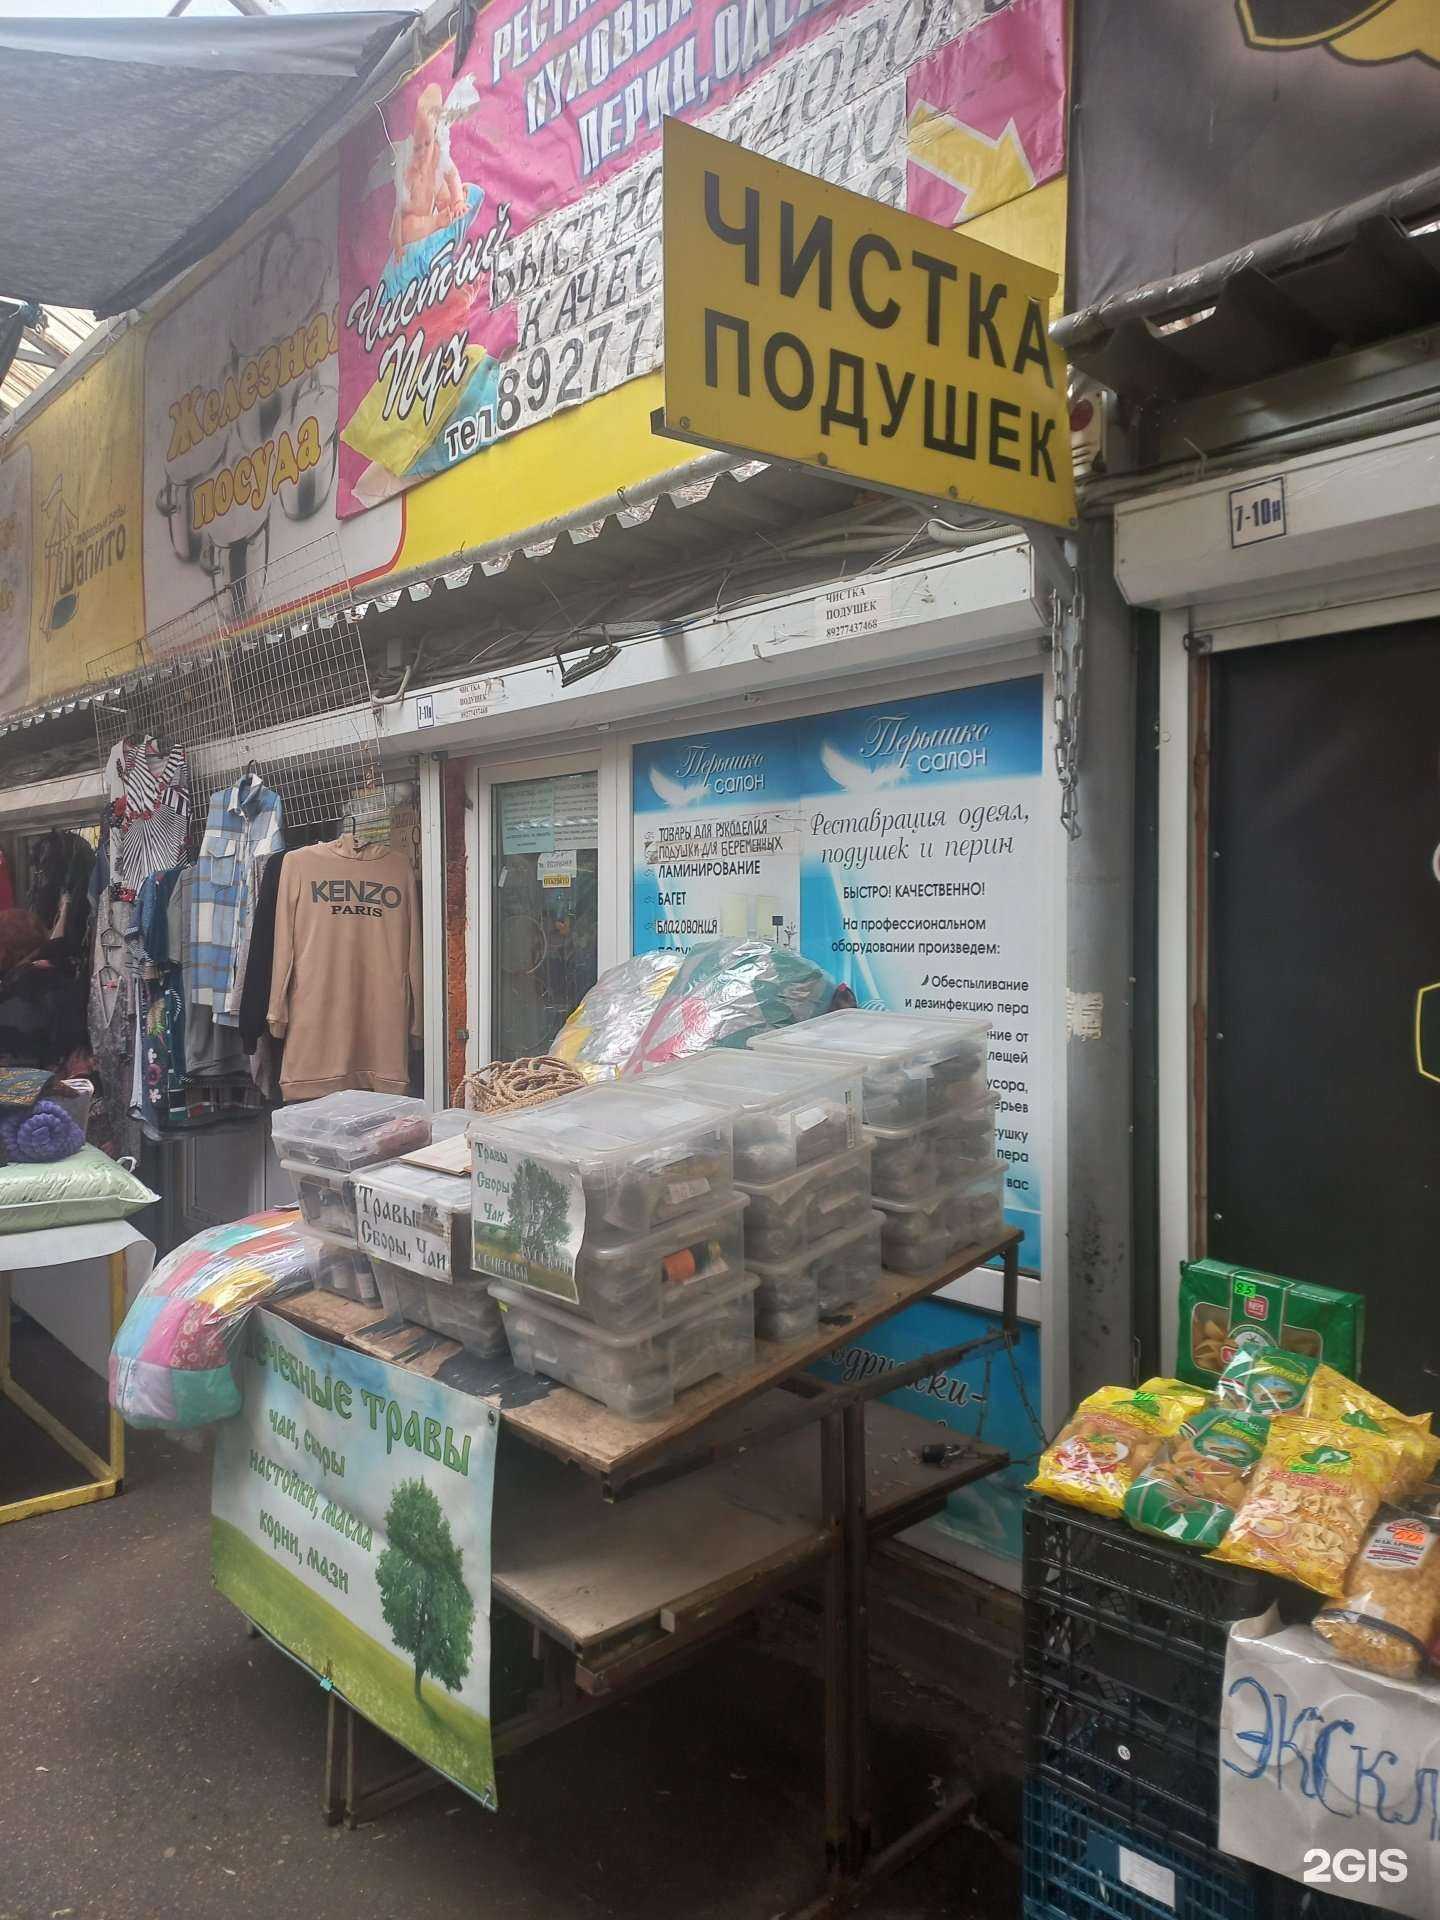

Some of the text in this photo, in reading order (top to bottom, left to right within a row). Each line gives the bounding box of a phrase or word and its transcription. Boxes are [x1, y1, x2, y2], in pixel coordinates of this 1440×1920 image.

[490, 165, 663, 312] БЫСТРО
[345, 202, 513, 352] Чистый
[703, 170, 1056, 389] ЧИСТКА
[495, 302, 663, 432] 89277
[376, 330, 470, 426] Пух
[704, 307, 1058, 484] ПОДУШЕК
[826, 586, 866, 603] ЧИСТКА
[826, 600, 877, 620] ПОДУШЕК
[860, 713, 992, 770] Перышко
[659, 819, 768, 842] ТОВАРЫ ДЛЯ РУКОДЕЛИЯ
[811, 802, 1033, 838] Реставрация одеял,
[659, 842, 700, 859] ПОДУШКИ
[721, 836, 783, 857] БЕРЕМЕННЫХ
[821, 836, 1015, 870] подушек и перин
[658, 860, 761, 879] ЛАМИНИРОВАНИЕ
[311, 879, 402, 909] KENZO
[657, 892, 687, 906] БАГЕТ
[843, 882, 986, 899] БЫСТРО! КАЧЕСТВЕННО!
[331, 905, 383, 918] PARIS
[843, 917, 986, 933] На профессиональном
[831, 939, 1001, 956] оборудовании произведем:
[931, 976, 1029, 992] Обеспыливание
[905, 997, 1029, 1016] и дезинфекцию пера
[1016, 1031, 1029, 1043] от
[997, 1149, 1029, 1163] пера
